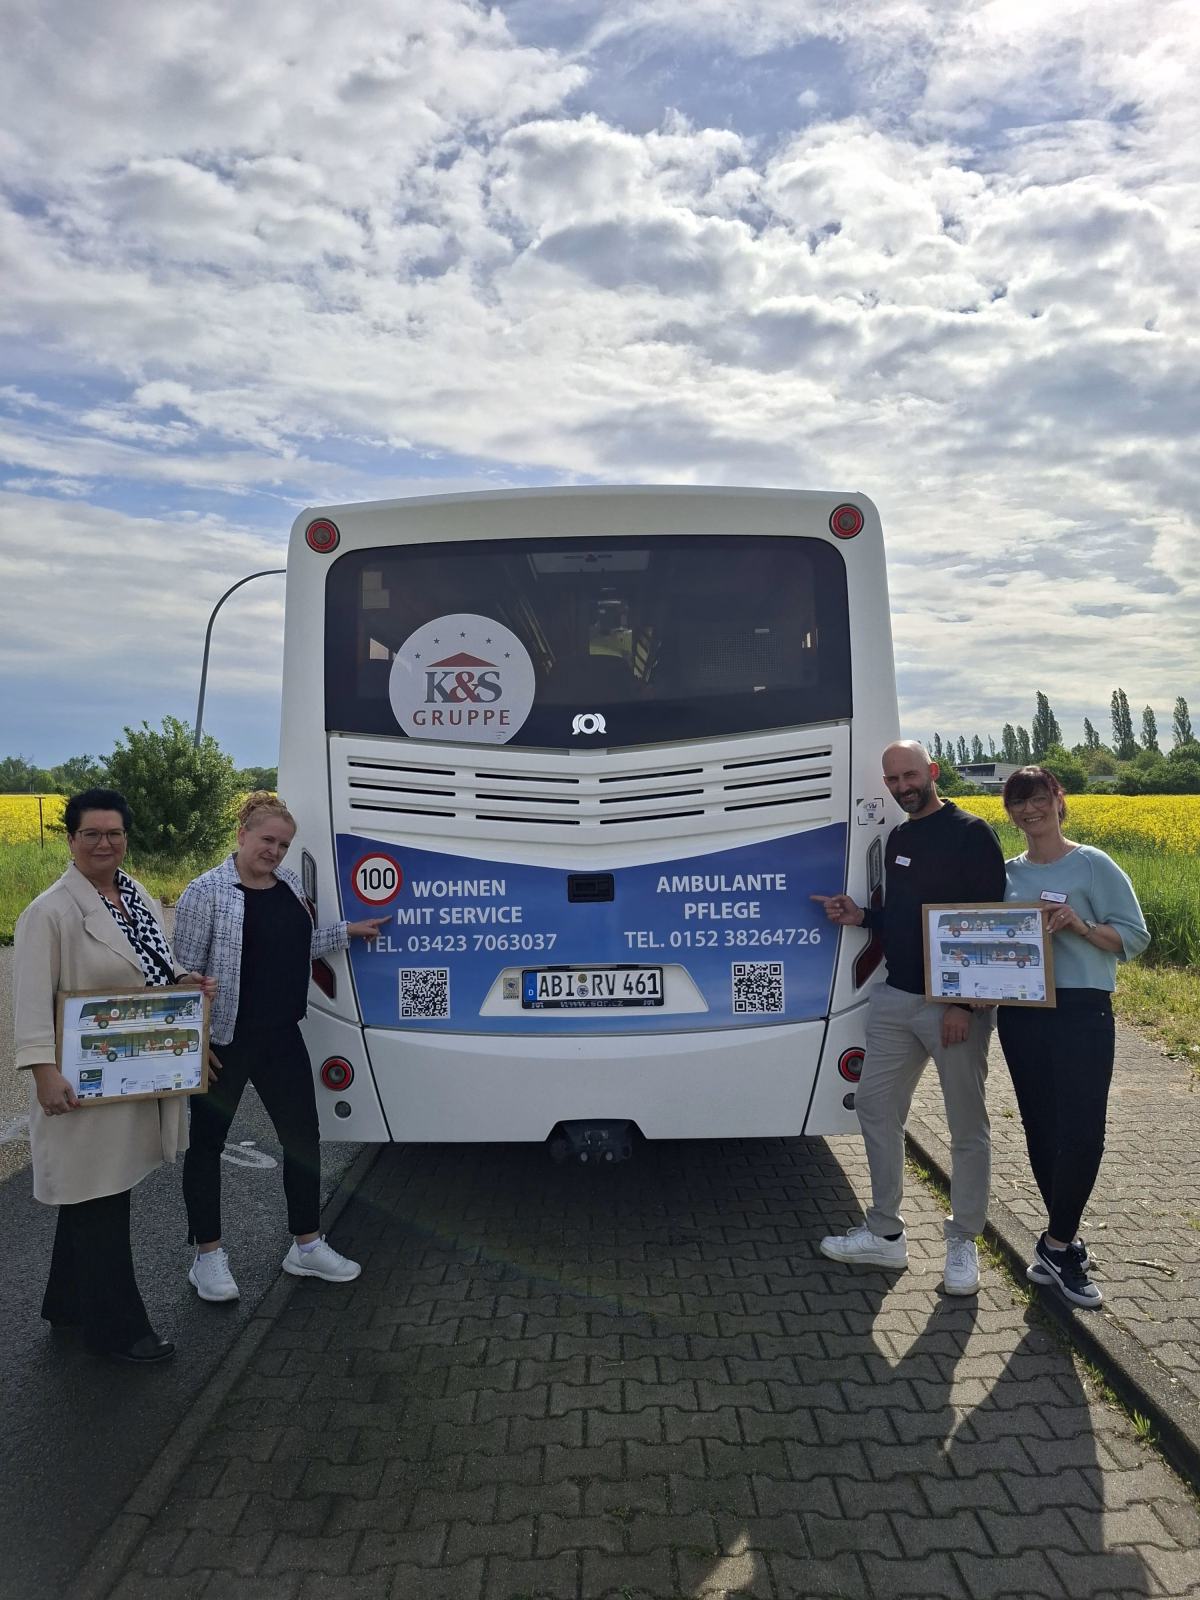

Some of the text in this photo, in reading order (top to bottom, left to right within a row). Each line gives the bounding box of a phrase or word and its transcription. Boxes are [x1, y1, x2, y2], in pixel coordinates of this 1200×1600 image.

[423, 671, 503, 704] K&S
[412, 709, 511, 726] GRUPPE
[360, 867, 396, 890] 100
[656, 873, 787, 893] AMBULANTE
[412, 879, 506, 898] WOHNEN
[397, 906, 523, 925] MIT SERVICE
[684, 901, 761, 920] PFLEGE
[407, 935, 467, 952] 03423
[473, 933, 557, 951] 7063037
[624, 927, 821, 949] TEL. 0152 38264726
[538, 974, 575, 997] ABI
[592, 973, 616, 996] RV
[622, 972, 659, 995] 461
